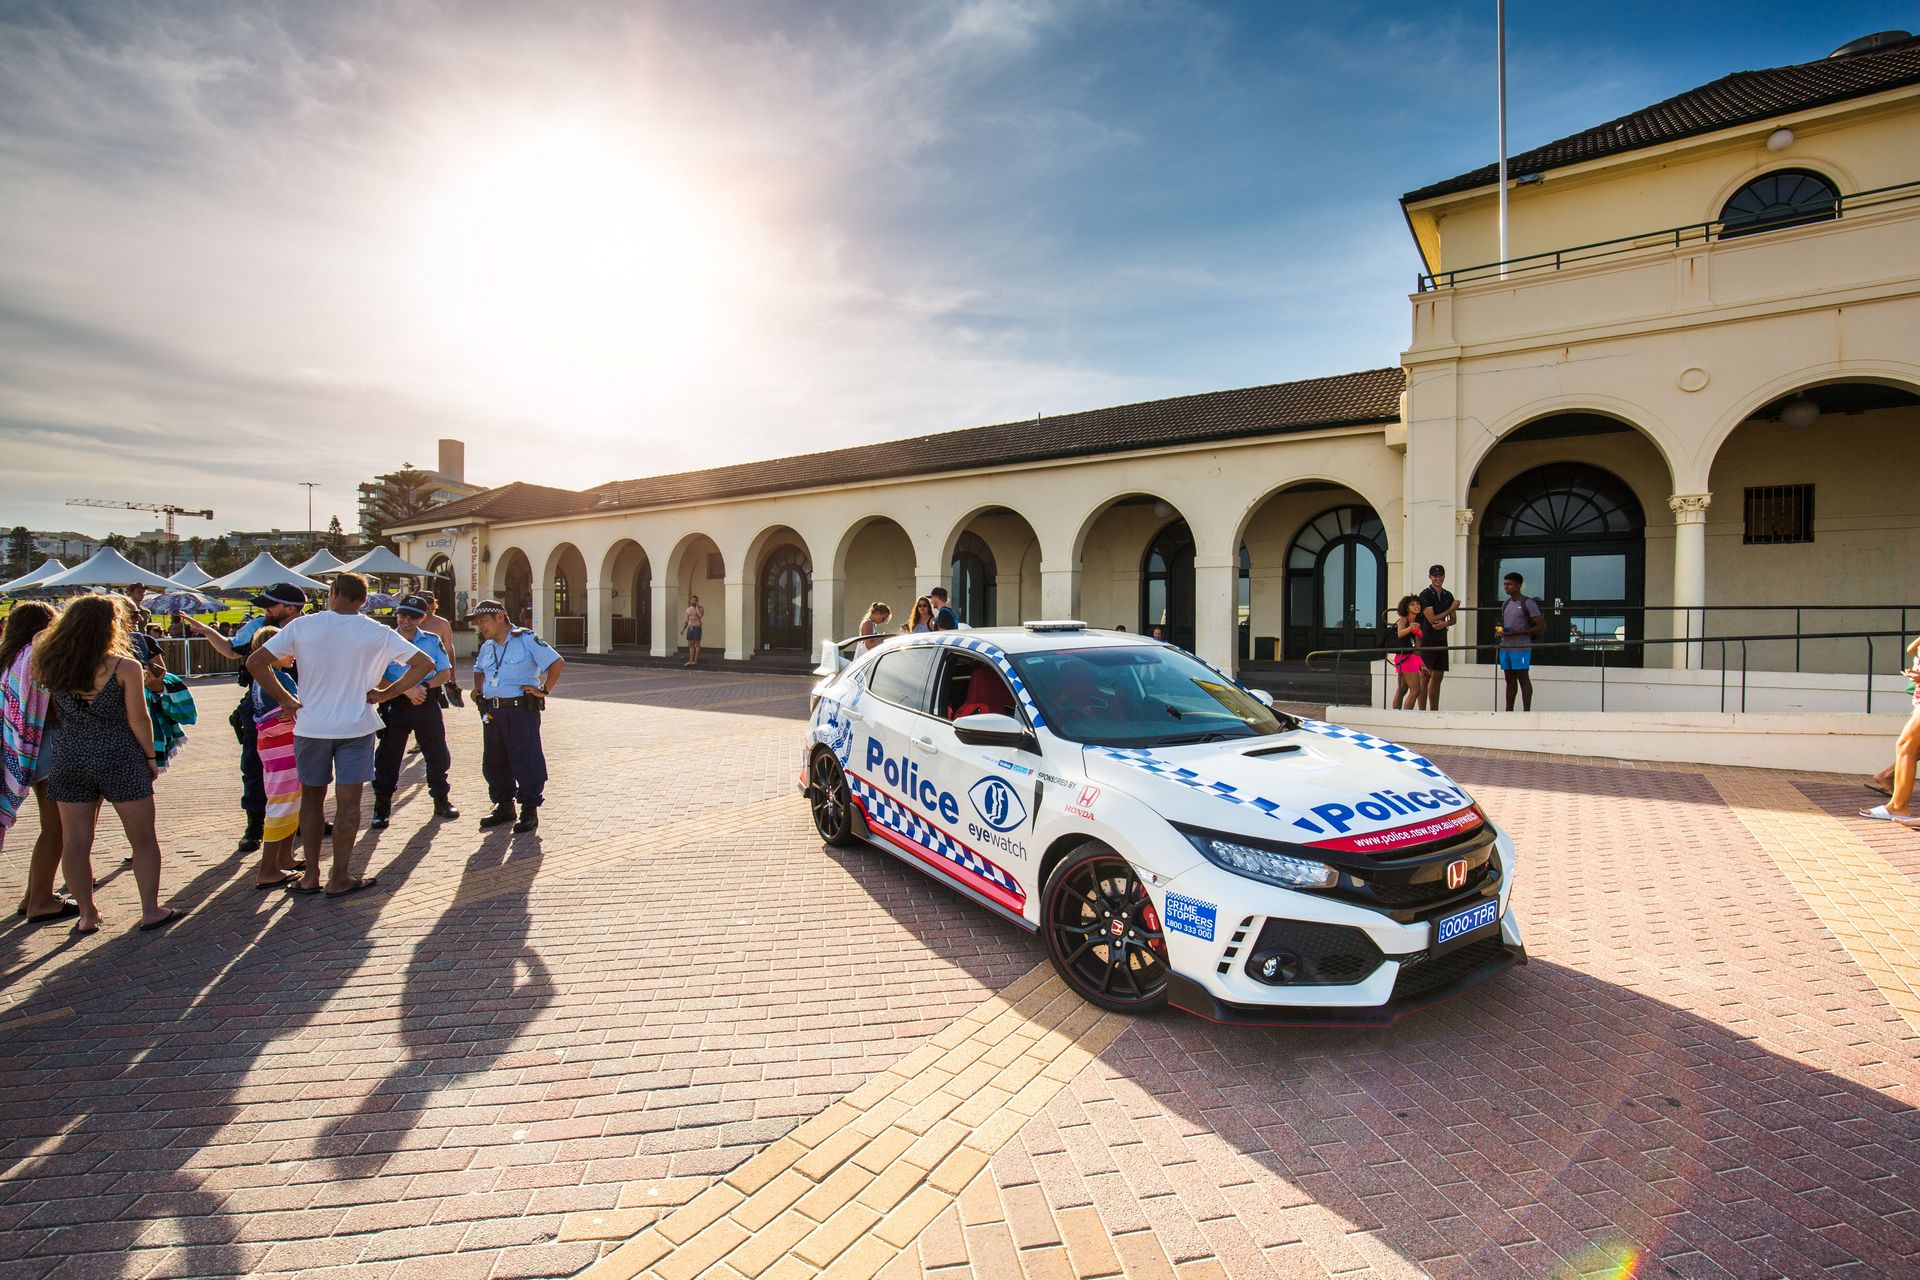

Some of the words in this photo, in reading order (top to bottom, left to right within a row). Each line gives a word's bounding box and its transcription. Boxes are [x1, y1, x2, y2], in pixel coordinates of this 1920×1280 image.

[865, 736, 960, 825] Police
[1038, 772, 1068, 787] SPONSORED
[1068, 781, 1076, 789] BY
[1064, 805, 1095, 820] HONDA
[1310, 788, 1462, 834] Police
[1353, 811, 1479, 847] www.police.nsw.gov.au/eyewatch
[968, 822, 1027, 861] eyewatch
[1166, 907, 1213, 929] STOPPERS
[1167, 898, 1198, 916] CRIME
[1166, 918, 1182, 930] 1800
[1183, 924, 1197, 934] 333
[1197, 929, 1212, 939] 000
